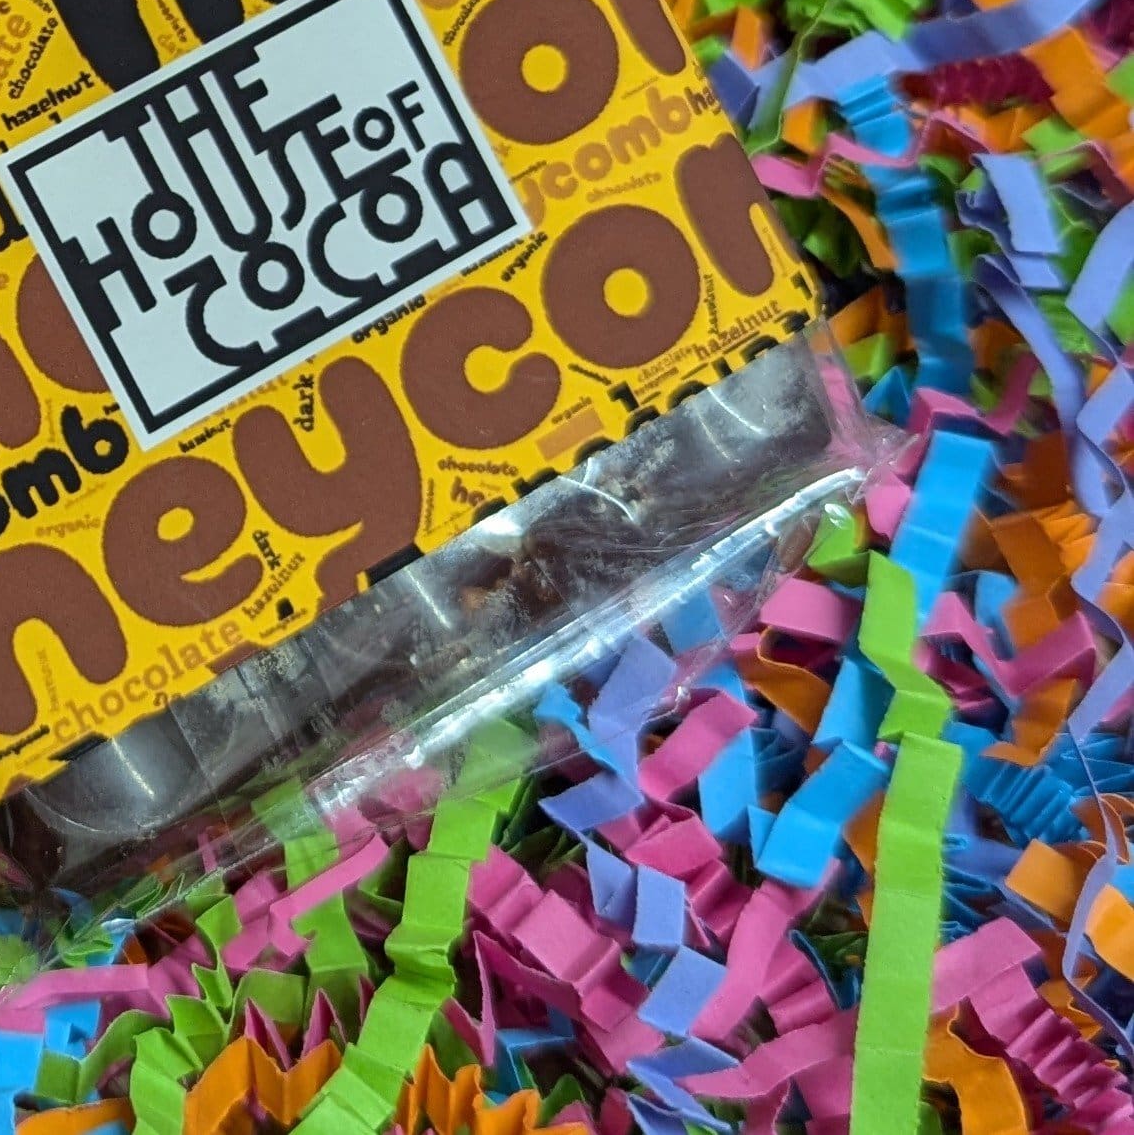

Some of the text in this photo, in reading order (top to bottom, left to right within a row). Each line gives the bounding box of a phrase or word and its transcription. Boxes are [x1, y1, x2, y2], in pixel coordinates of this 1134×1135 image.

[8, 16, 59, 101] chocolate
[0, 70, 96, 132] hazelnut
[103, 46, 268, 194] THE
[63, 81, 424, 334] HOUSE OF
[164, 142, 514, 369] COCOA
[500, 231, 548, 284] organic
[350, 293, 427, 345] organic
[692, 299, 782, 362] hazelnut
[293, 374, 316, 433] dark
[436, 455, 519, 478] chocolate
[35, 513, 102, 539] organic
[252, 529, 282, 571] dark
[241, 551, 307, 622] hazelnut
[53, 620, 245, 744] chocolate
